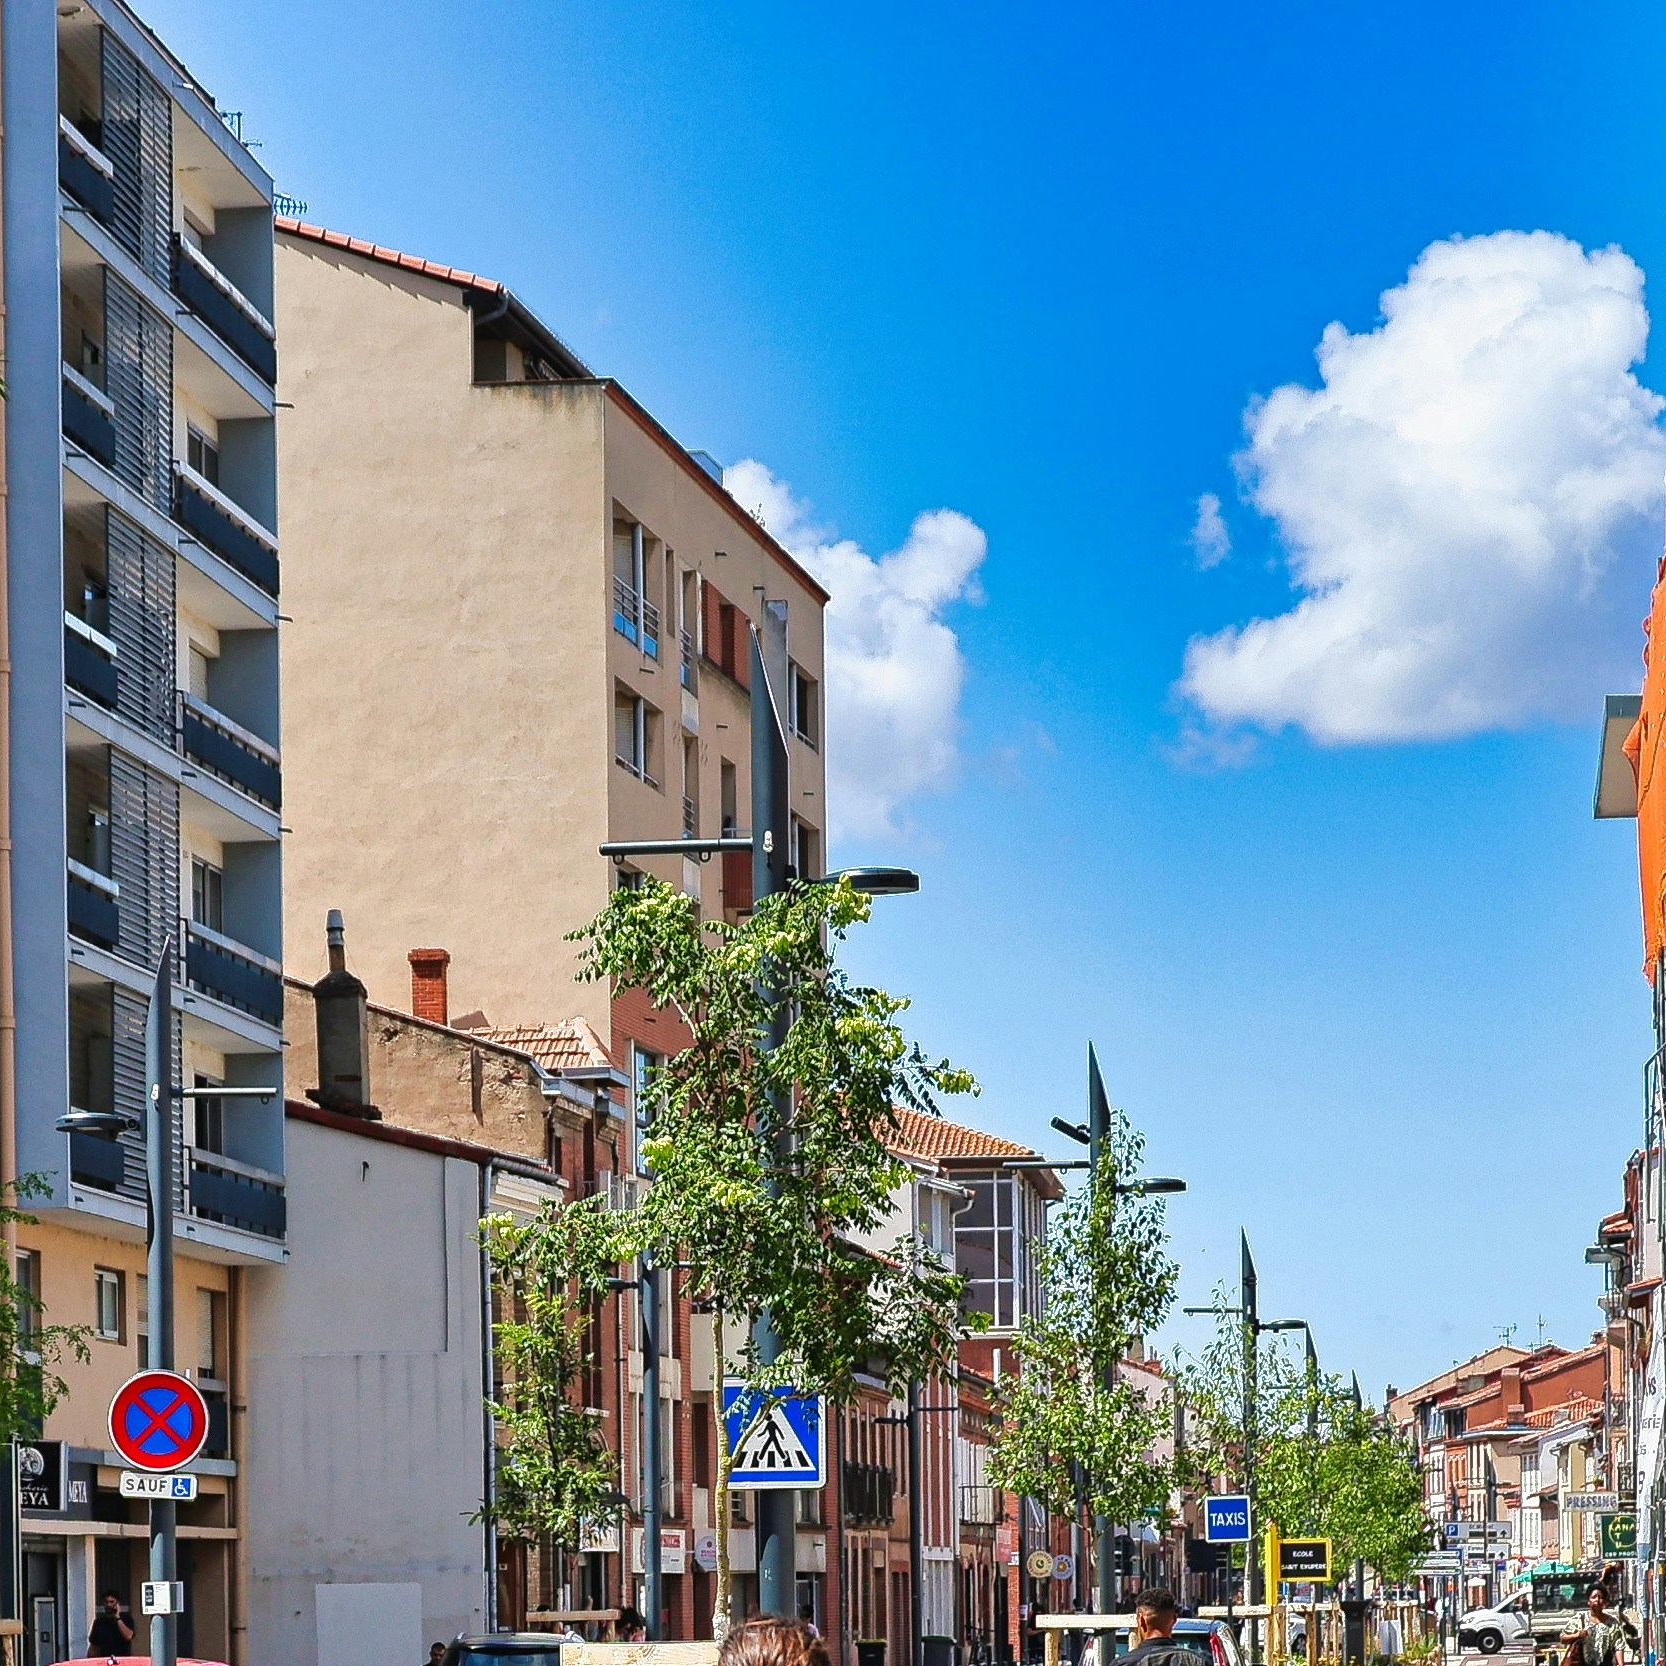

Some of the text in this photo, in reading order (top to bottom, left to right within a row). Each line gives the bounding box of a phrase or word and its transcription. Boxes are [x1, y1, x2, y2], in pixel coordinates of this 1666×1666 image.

[125, 1478, 167, 1492] SAUF
[68, 1481, 87, 1503] MEYA
[20, 1494, 49, 1506] EYA
[1566, 1495, 1617, 1508] PRESSING
[1210, 1512, 1245, 1526] TAXIS
[1292, 1550, 1314, 1558] ECOLE
